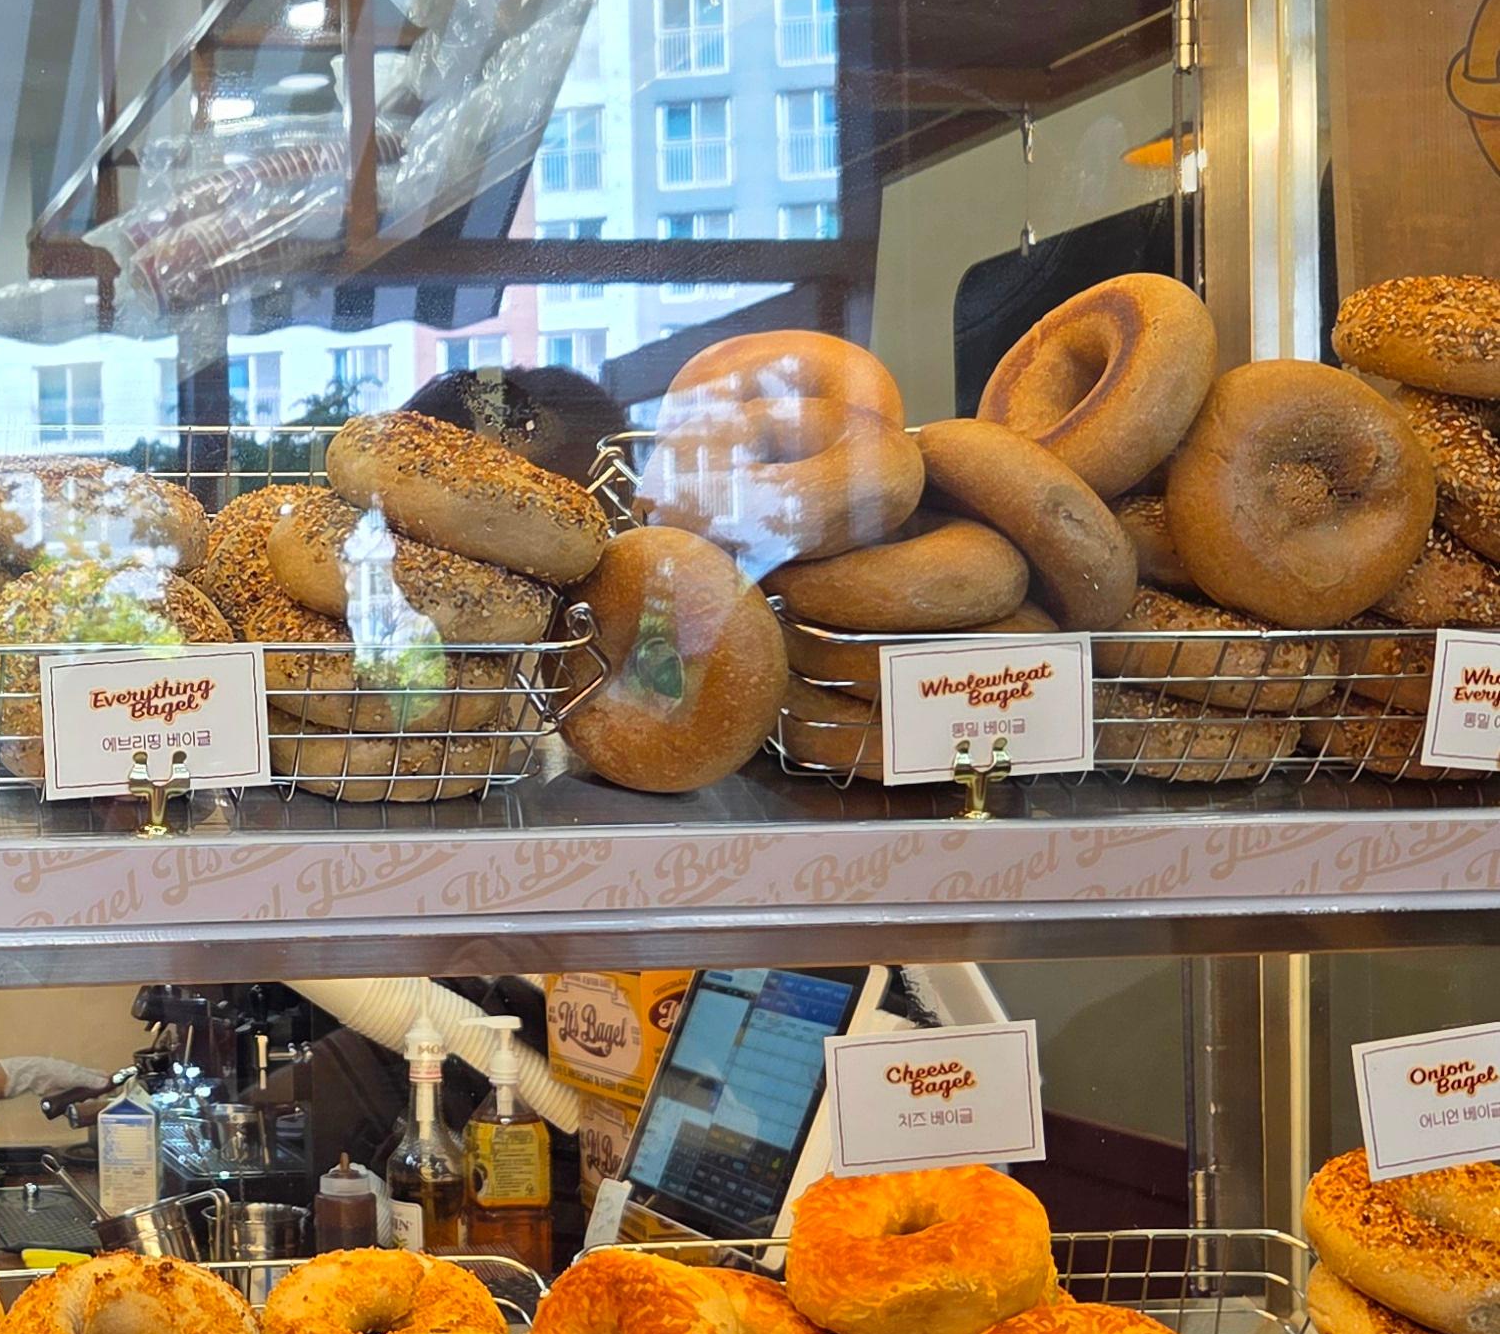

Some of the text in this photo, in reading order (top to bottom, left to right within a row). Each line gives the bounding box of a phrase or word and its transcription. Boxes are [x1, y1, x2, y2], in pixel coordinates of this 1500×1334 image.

[91, 678, 215, 710] Everything
[919, 662, 1052, 701] Wholewheat
[967, 681, 1033, 709] Bagel
[129, 694, 200, 723] Bagel
[1464, 712, 1490, 729] 통밀
[950, 717, 1027, 738] 통밀 베이글
[101, 730, 212, 753] 에브리띵 베이글
[886, 1061, 962, 1085] Cheese
[910, 1070, 976, 1099] Bagel
[1409, 1060, 1476, 1085] Onion
[1435, 1065, 1499, 1095] Bagel
[898, 1107, 974, 1129] 치즈 베이글
[1419, 1108, 1460, 1129] 어니언
